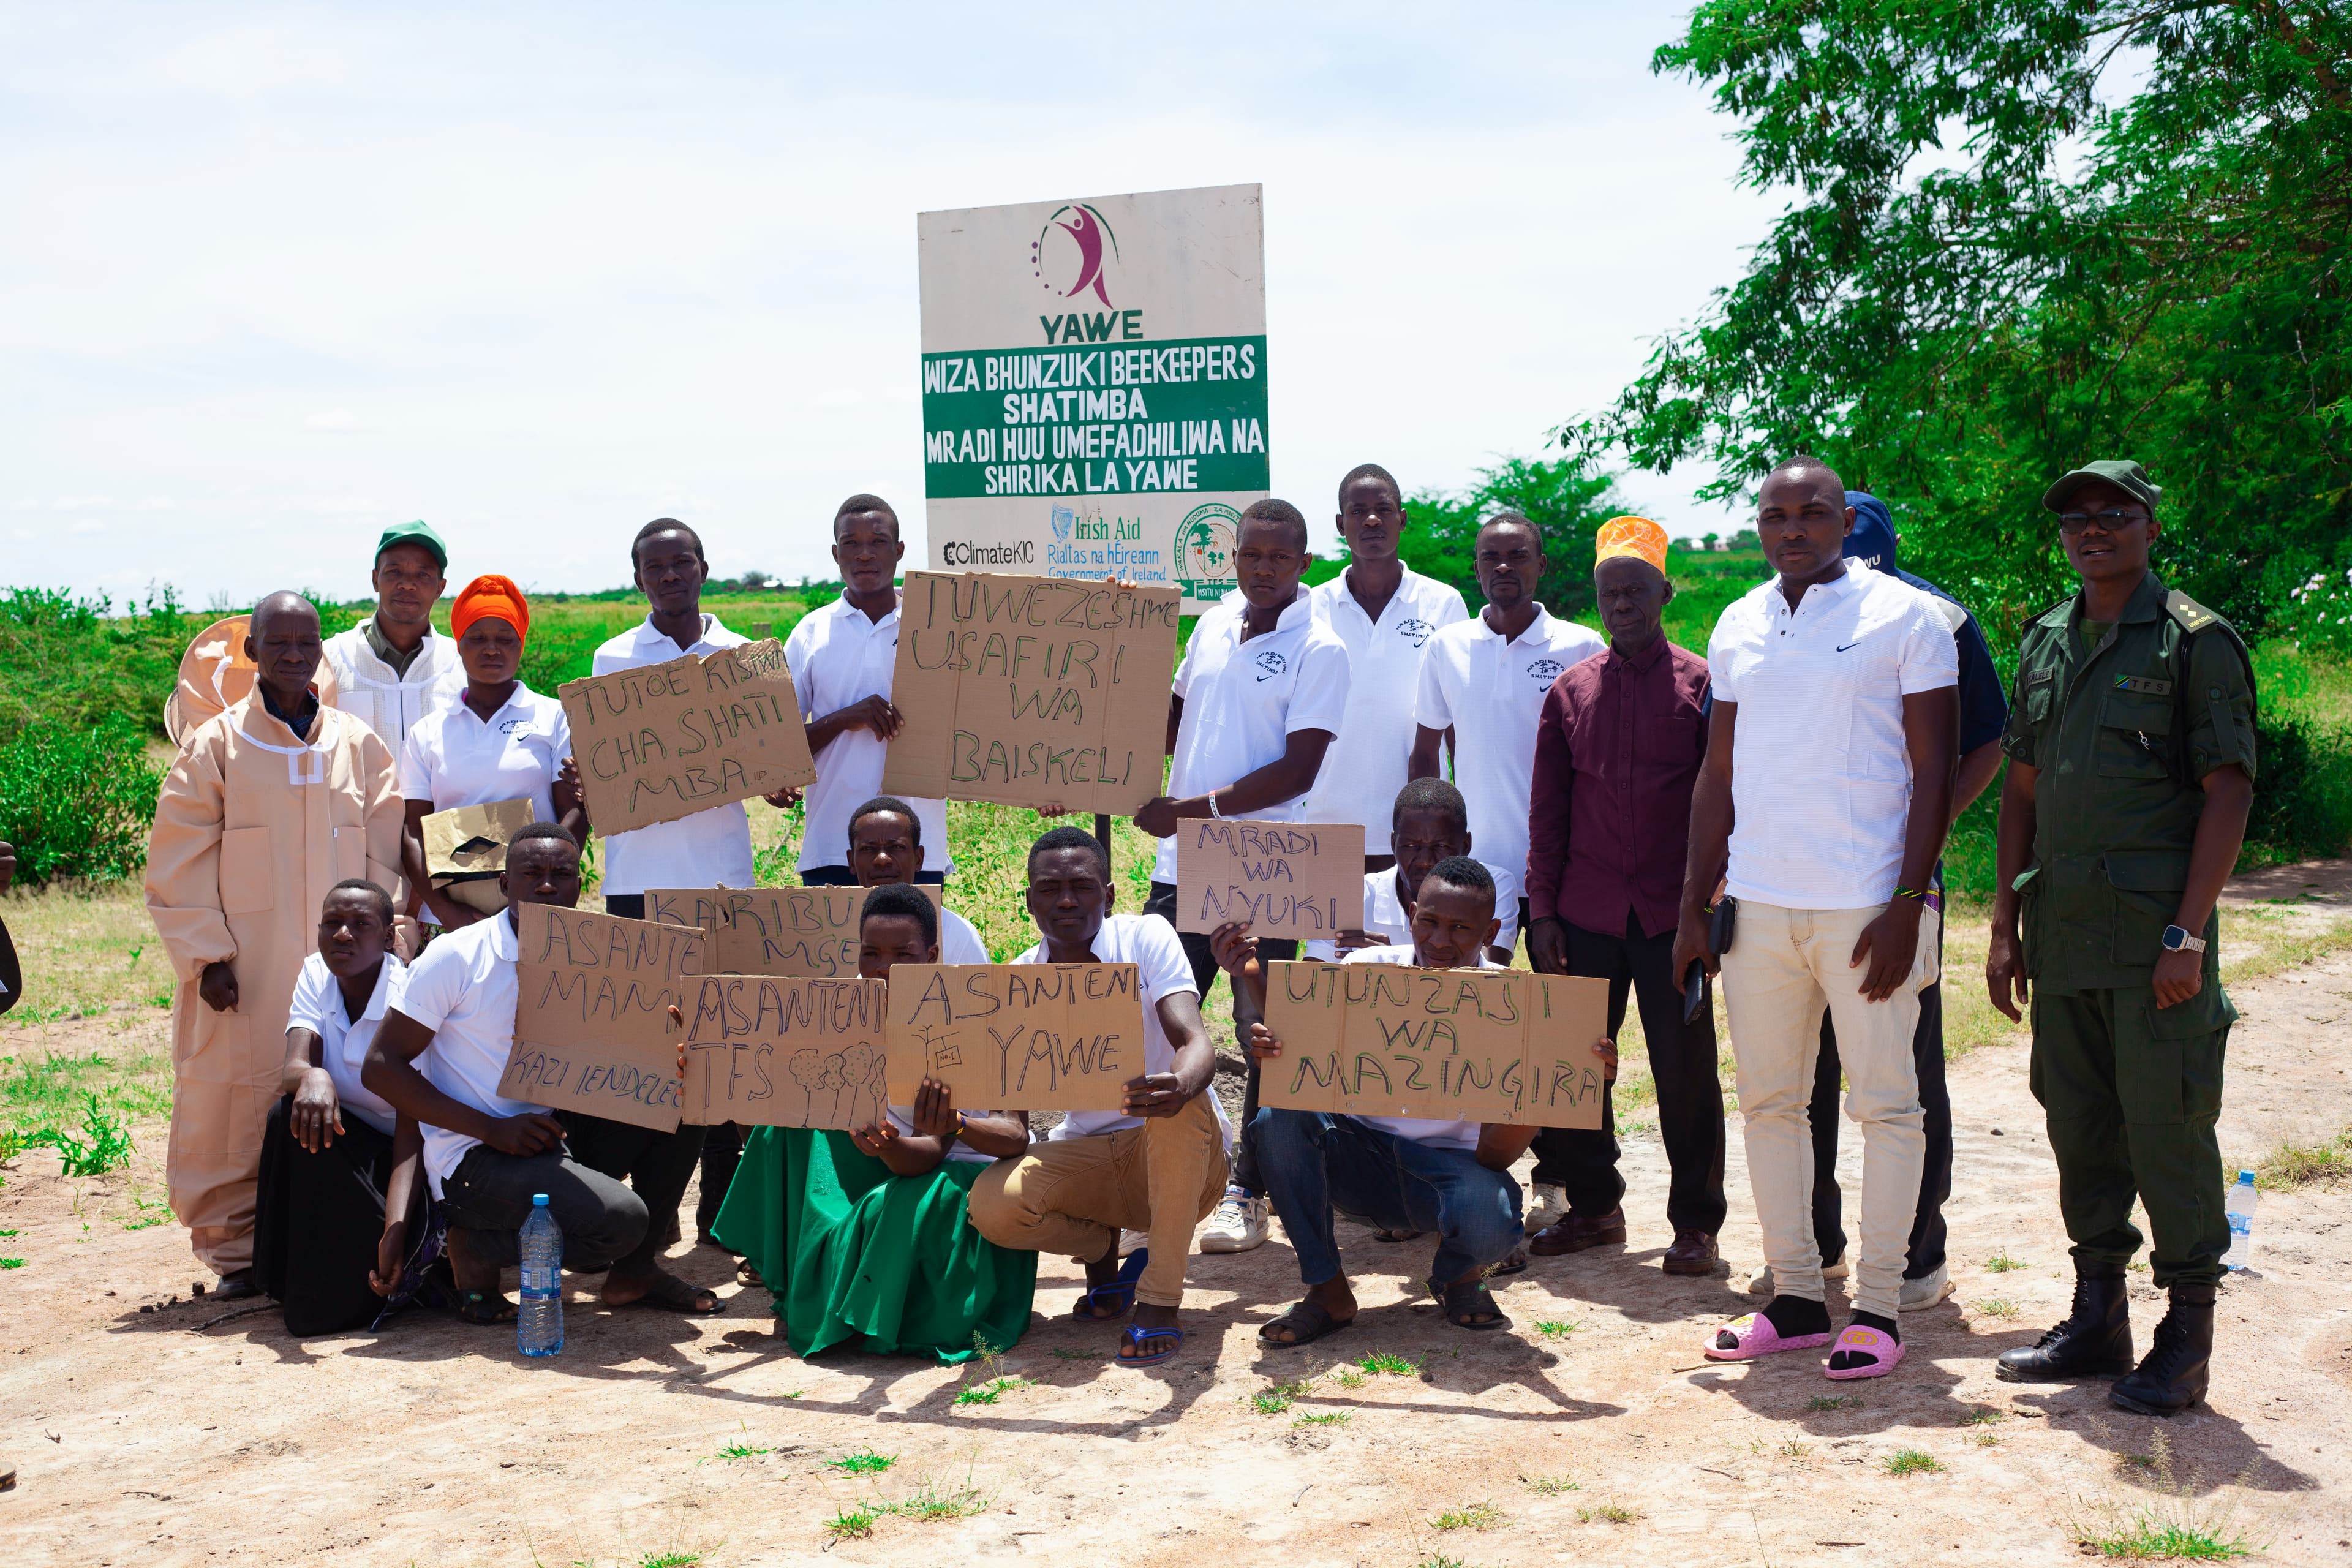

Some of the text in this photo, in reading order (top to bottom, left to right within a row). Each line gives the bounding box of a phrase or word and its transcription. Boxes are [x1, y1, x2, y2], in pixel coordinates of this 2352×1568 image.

[1039, 309, 1143, 345] YAWE
[924, 344, 1255, 393] WIZA BHUNZUKI BEEKEEPERS
[1003, 389, 1148, 424] SHATIMBA
[927, 418, 1265, 463] MRADI HUU UMEFADHILIWA NA
[985, 459, 1197, 494] SHIRIKA LA YAWE
[1075, 516, 1141, 540] Irish Aid
[1224, 509, 1241, 521] MISIT
[1047, 543, 1087, 564] Rialtas
[1091, 550, 1104, 564] na
[1117, 565, 1128, 580] of
[1133, 565, 1167, 581] Ireland
[1197, 588, 1213, 597] MSITU
[912, 630, 1125, 688] USAFIRI
[570, 666, 690, 726] TUTOE
[1010, 682, 1083, 725] WA
[589, 692, 783, 781] CHA SHATI
[951, 729, 1133, 785] BAISKELI
[1197, 824, 1320, 857] MRADI
[1242, 859, 1294, 882] WA
[650, 892, 854, 937] KARIBU
[1201, 884, 1336, 929] NYUKI
[539, 909, 704, 982] ASANTE
[762, 933, 861, 976] MGE
[537, 970, 683, 1034] MAM
[688, 976, 881, 1041] ASANTENI
[907, 965, 1139, 1025] ASANTENI
[1376, 1018, 1459, 1054] WA
[503, 1041, 570, 1088] KAZI
[689, 1042, 774, 1109] TFS
[987, 1025, 1121, 1097] YAWE
[1290, 1050, 1602, 1112] MAZINGIRA
